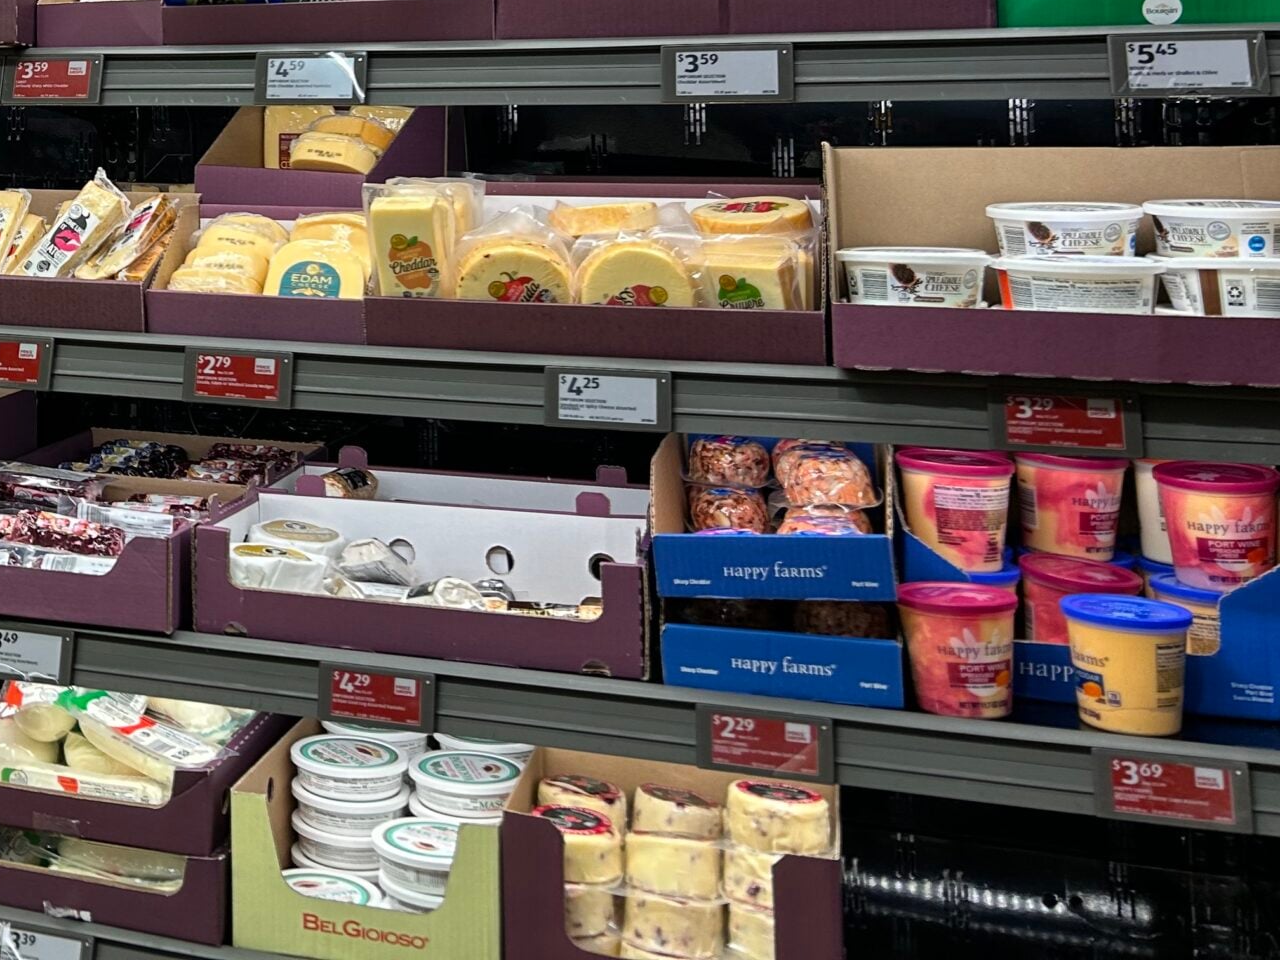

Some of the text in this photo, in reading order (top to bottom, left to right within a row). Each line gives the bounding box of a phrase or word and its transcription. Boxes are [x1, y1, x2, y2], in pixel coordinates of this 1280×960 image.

[1061, 239, 1101, 247] CHEESE
[390, 257, 437, 275] Cheddar
[291, 273, 332, 284] EDAM
[925, 284, 961, 293] CHEESE
[1072, 497, 1113, 509] Happy
[1187, 520, 1230, 537] Happy
[1208, 540, 1261, 548] PORT WINE
[723, 561, 824, 581] Happy farms
[937, 641, 1011, 659] Happy farm
[731, 656, 832, 677] Happy farms
[960, 663, 1007, 673] PORT WINE
[1020, 661, 1076, 683] Happ
